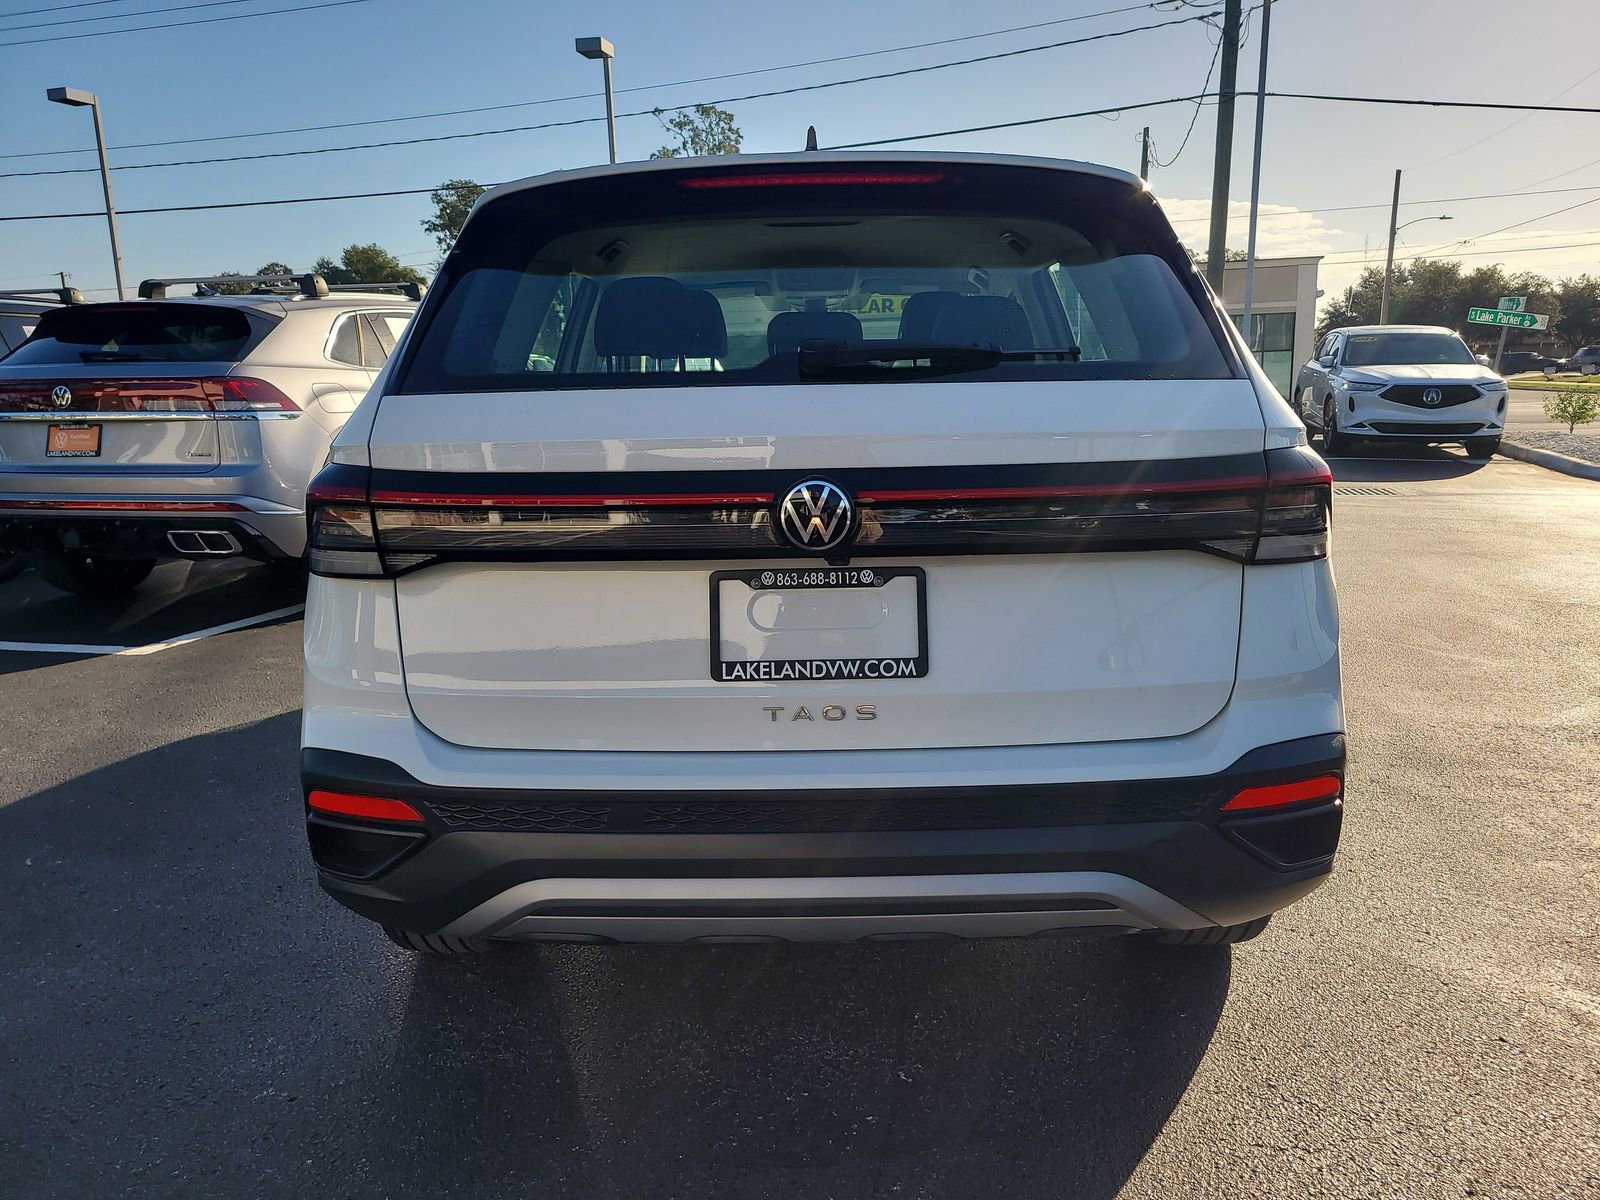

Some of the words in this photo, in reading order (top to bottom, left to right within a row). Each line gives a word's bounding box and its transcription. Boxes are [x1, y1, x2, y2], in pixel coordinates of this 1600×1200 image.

[1471, 311, 1476, 319] S
[1476, 310, 1494, 322] Lake
[1497, 312, 1523, 325] Parker
[776, 571, 858, 586] 863-688-8112
[721, 659, 917, 680] LAKELANDVW.COM
[763, 704, 878, 722] TAOS
